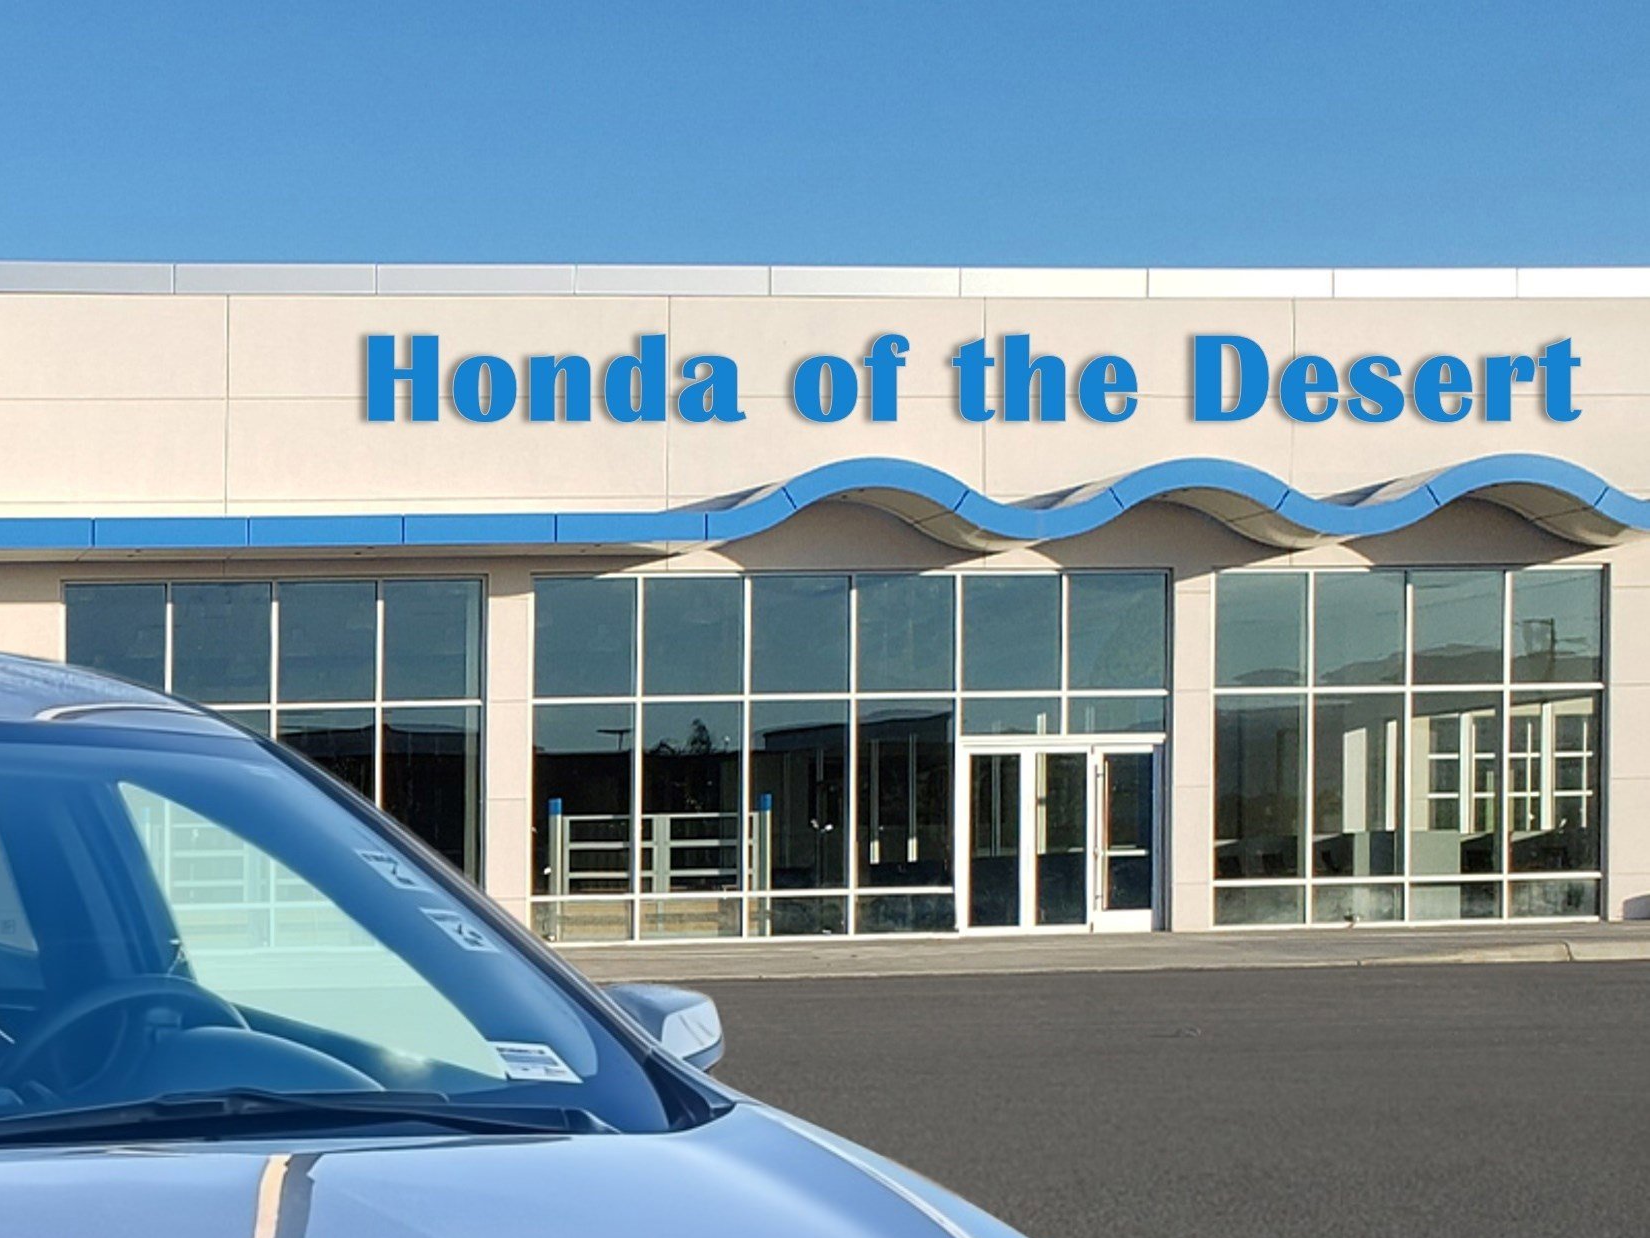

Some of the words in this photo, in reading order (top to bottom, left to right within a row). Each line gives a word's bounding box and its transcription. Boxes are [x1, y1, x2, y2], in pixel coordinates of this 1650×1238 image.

[366, 333, 747, 423] Honda
[793, 333, 910, 423] of
[951, 333, 1139, 423] the
[1193, 335, 1582, 423] Desert
